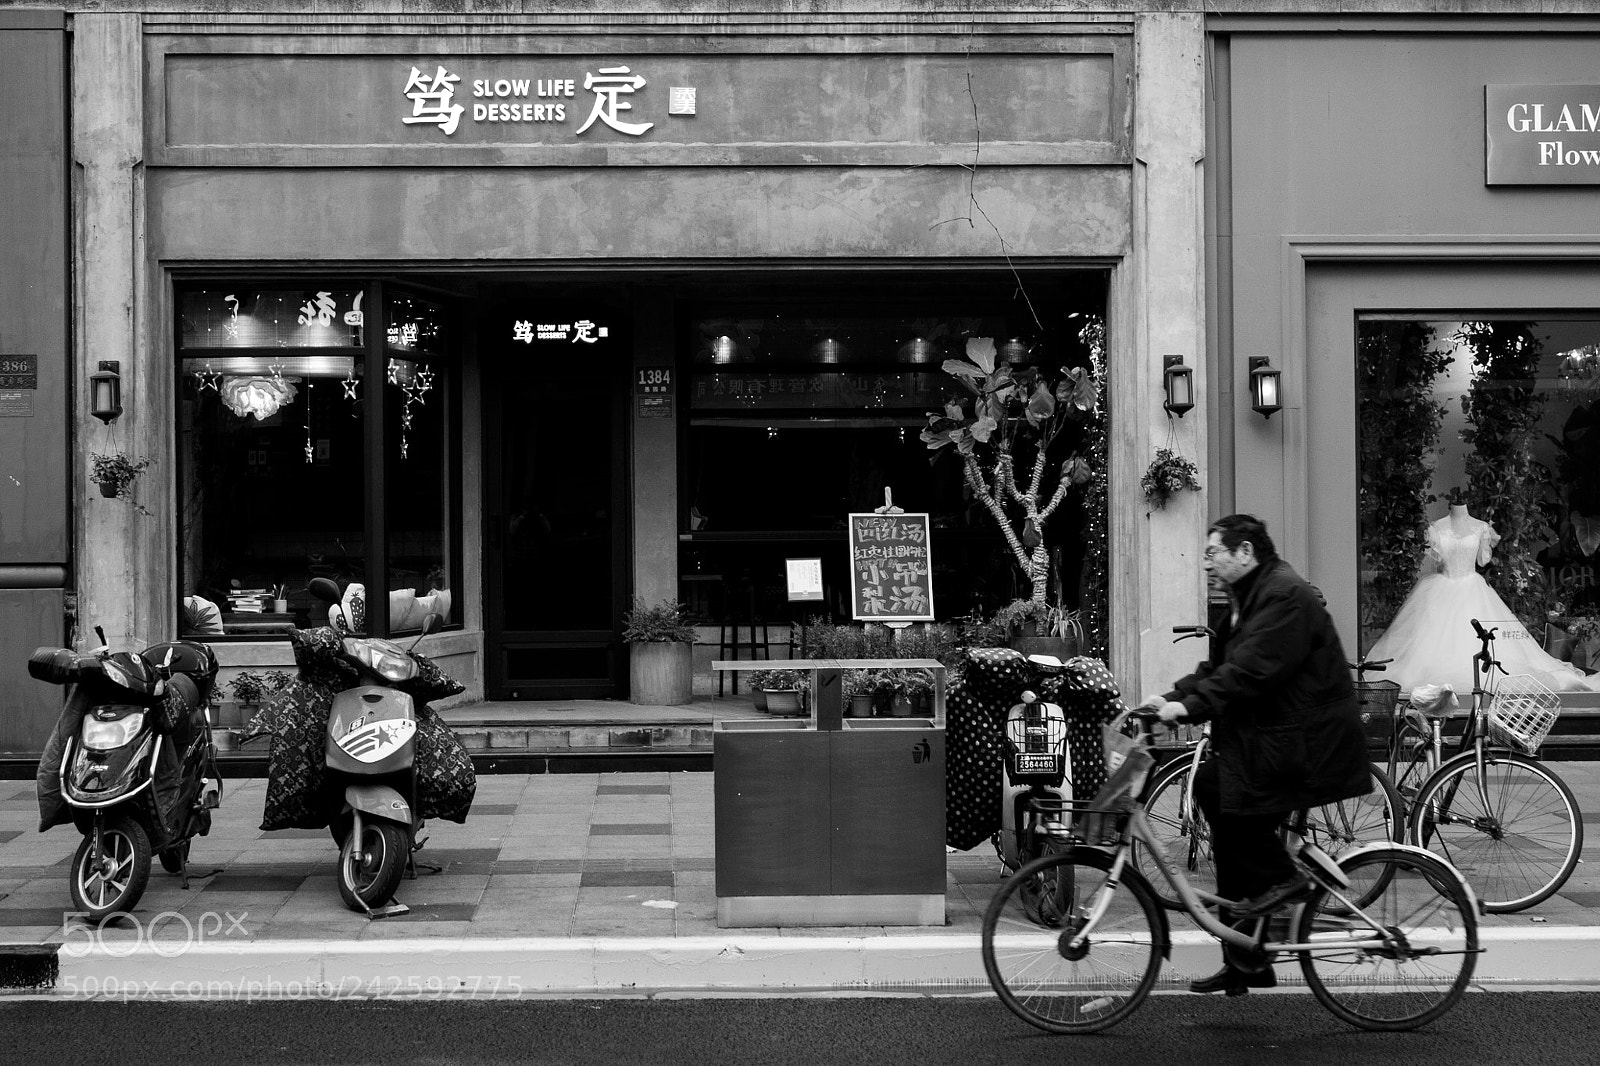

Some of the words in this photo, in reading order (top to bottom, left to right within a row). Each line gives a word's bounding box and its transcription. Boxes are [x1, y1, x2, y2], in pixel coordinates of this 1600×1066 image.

[473, 79, 531, 97] SLOW
[537, 79, 575, 97] LIFE
[575, 65, 655, 136] 定
[473, 104, 566, 122] DESSERTS
[1507, 103, 1600, 132] GLAM
[1538, 141, 1600, 166] Flow
[639, 370, 671, 384] 1384
